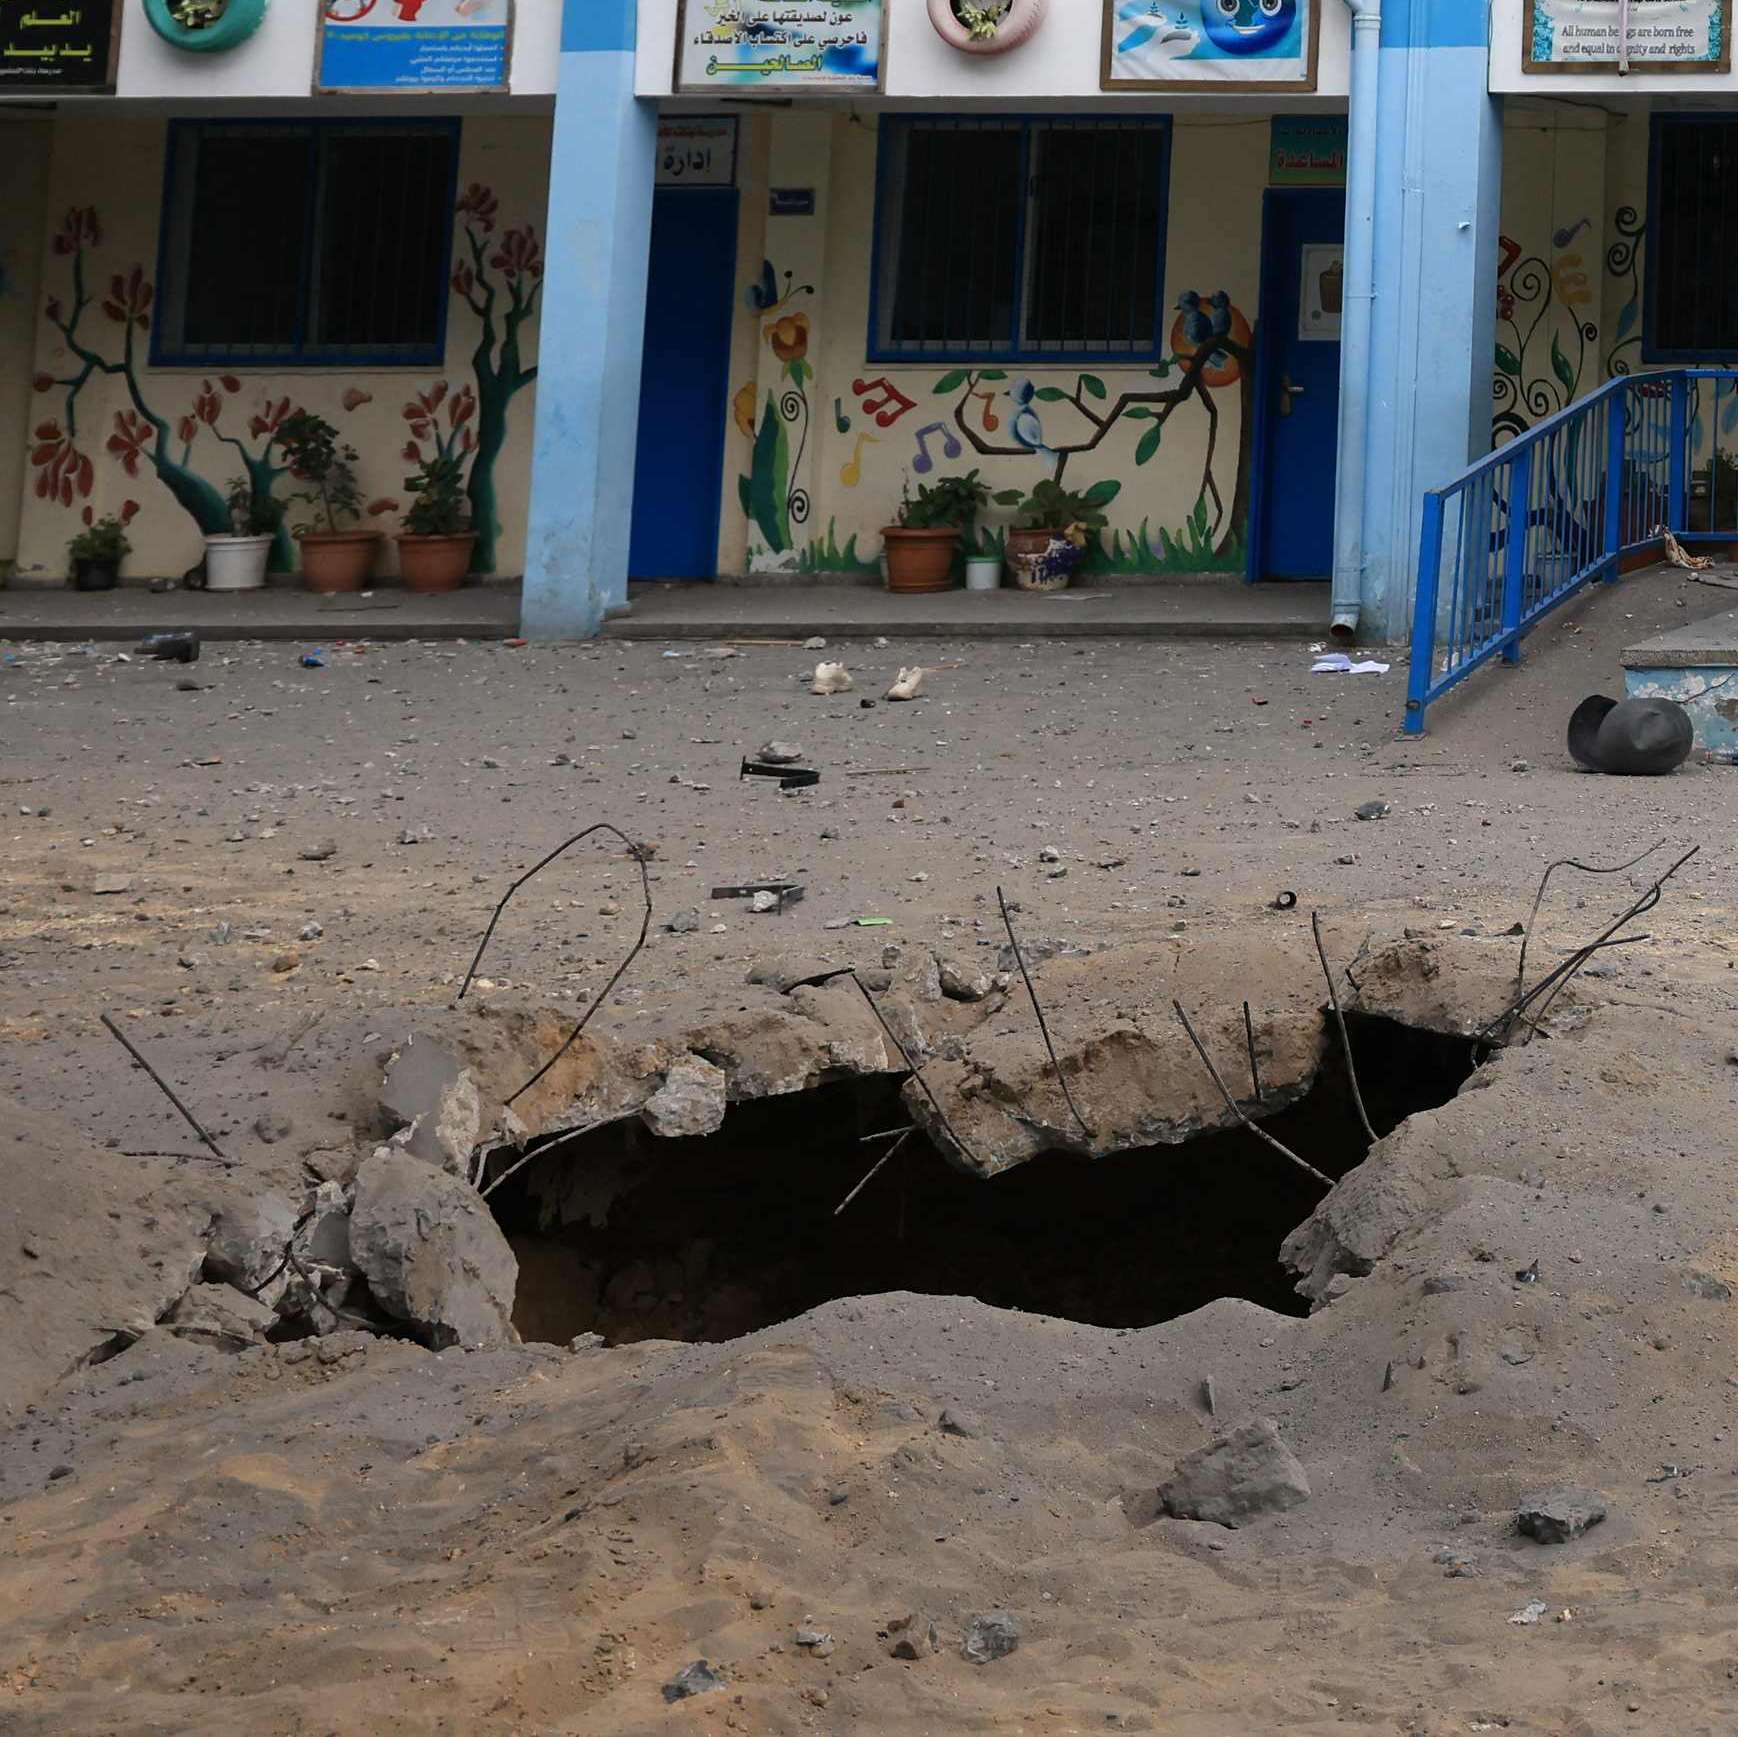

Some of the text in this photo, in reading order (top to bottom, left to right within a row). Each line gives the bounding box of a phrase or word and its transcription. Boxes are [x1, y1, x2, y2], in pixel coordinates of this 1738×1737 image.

[20, 8, 81, 30] العلم
[716, 10, 853, 26] عون لصديقتها على الخير
[750, 31, 792, 47] اكتساب
[792, 33, 816, 47] على
[1562, 25, 1695, 39] All human begs are born free
[818, 32, 868, 49] فاحرصي
[1562, 42, 1581, 54] and
[1581, 43, 1606, 57] equal
[1606, 43, 1616, 54] in
[1648, 42, 1667, 54] and
[1668, 42, 1696, 57] rights
[705, 54, 824, 76] الصالحين
